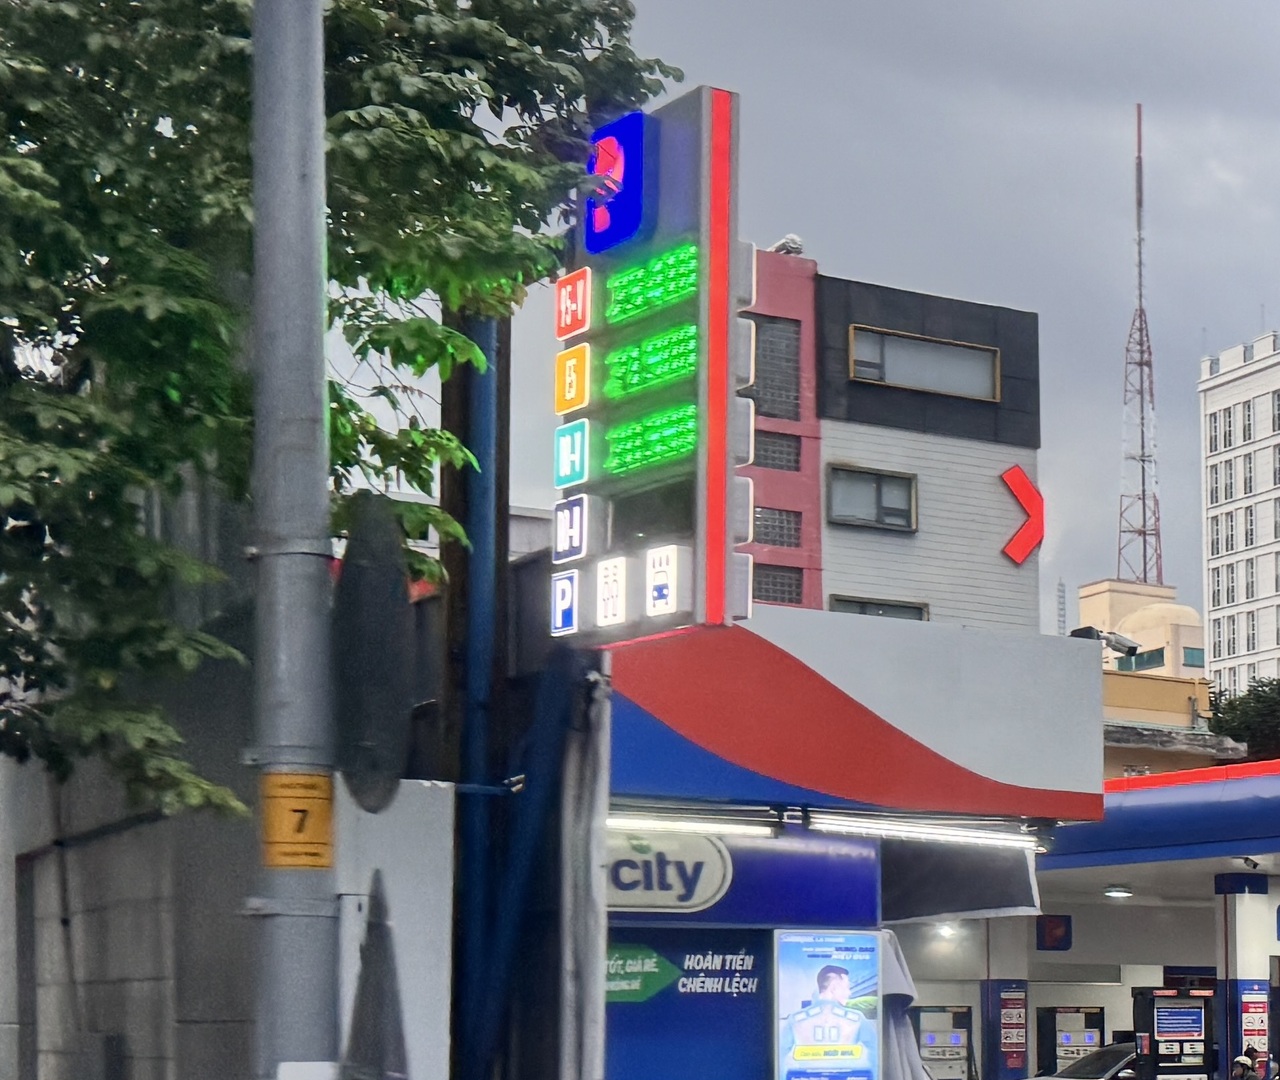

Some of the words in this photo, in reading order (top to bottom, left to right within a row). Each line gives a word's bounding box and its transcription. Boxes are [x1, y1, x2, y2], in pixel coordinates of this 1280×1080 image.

[555, 578, 572, 627] P
[290, 809, 309, 833] 7
[683, 951, 722, 971] HOÀN
[677, 973, 722, 994] CHÊNH
[724, 973, 758, 997] LỆCH
